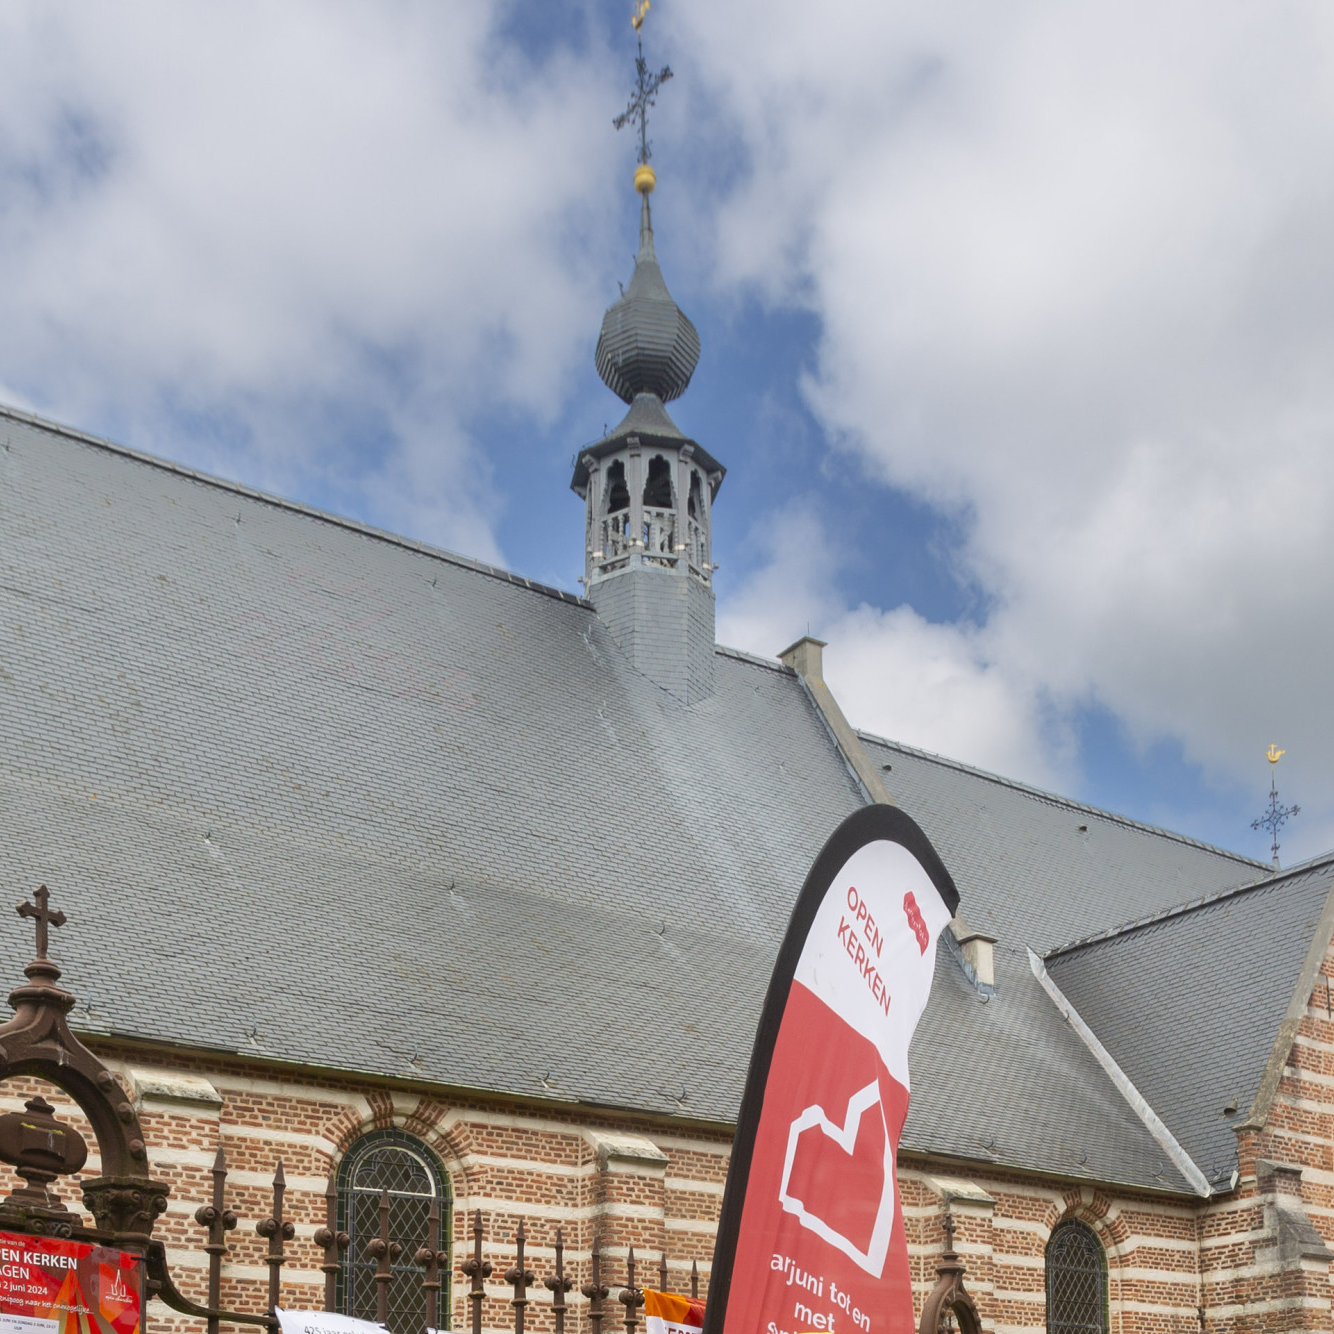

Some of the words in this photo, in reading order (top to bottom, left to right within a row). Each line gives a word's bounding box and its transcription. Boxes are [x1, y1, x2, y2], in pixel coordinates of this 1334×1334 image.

[847, 886, 883, 958] OPEN
[838, 915, 890, 1017] KERKEN
[24, 1251, 77, 1270] KERKEN
[3, 1280, 8, 1289] 2
[10, 1281, 25, 1292] juni
[28, 1283, 48, 1295] 2024
[829, 1282, 851, 1315] tot
[852, 1307, 870, 1333] en
[794, 1302, 835, 1333] met
